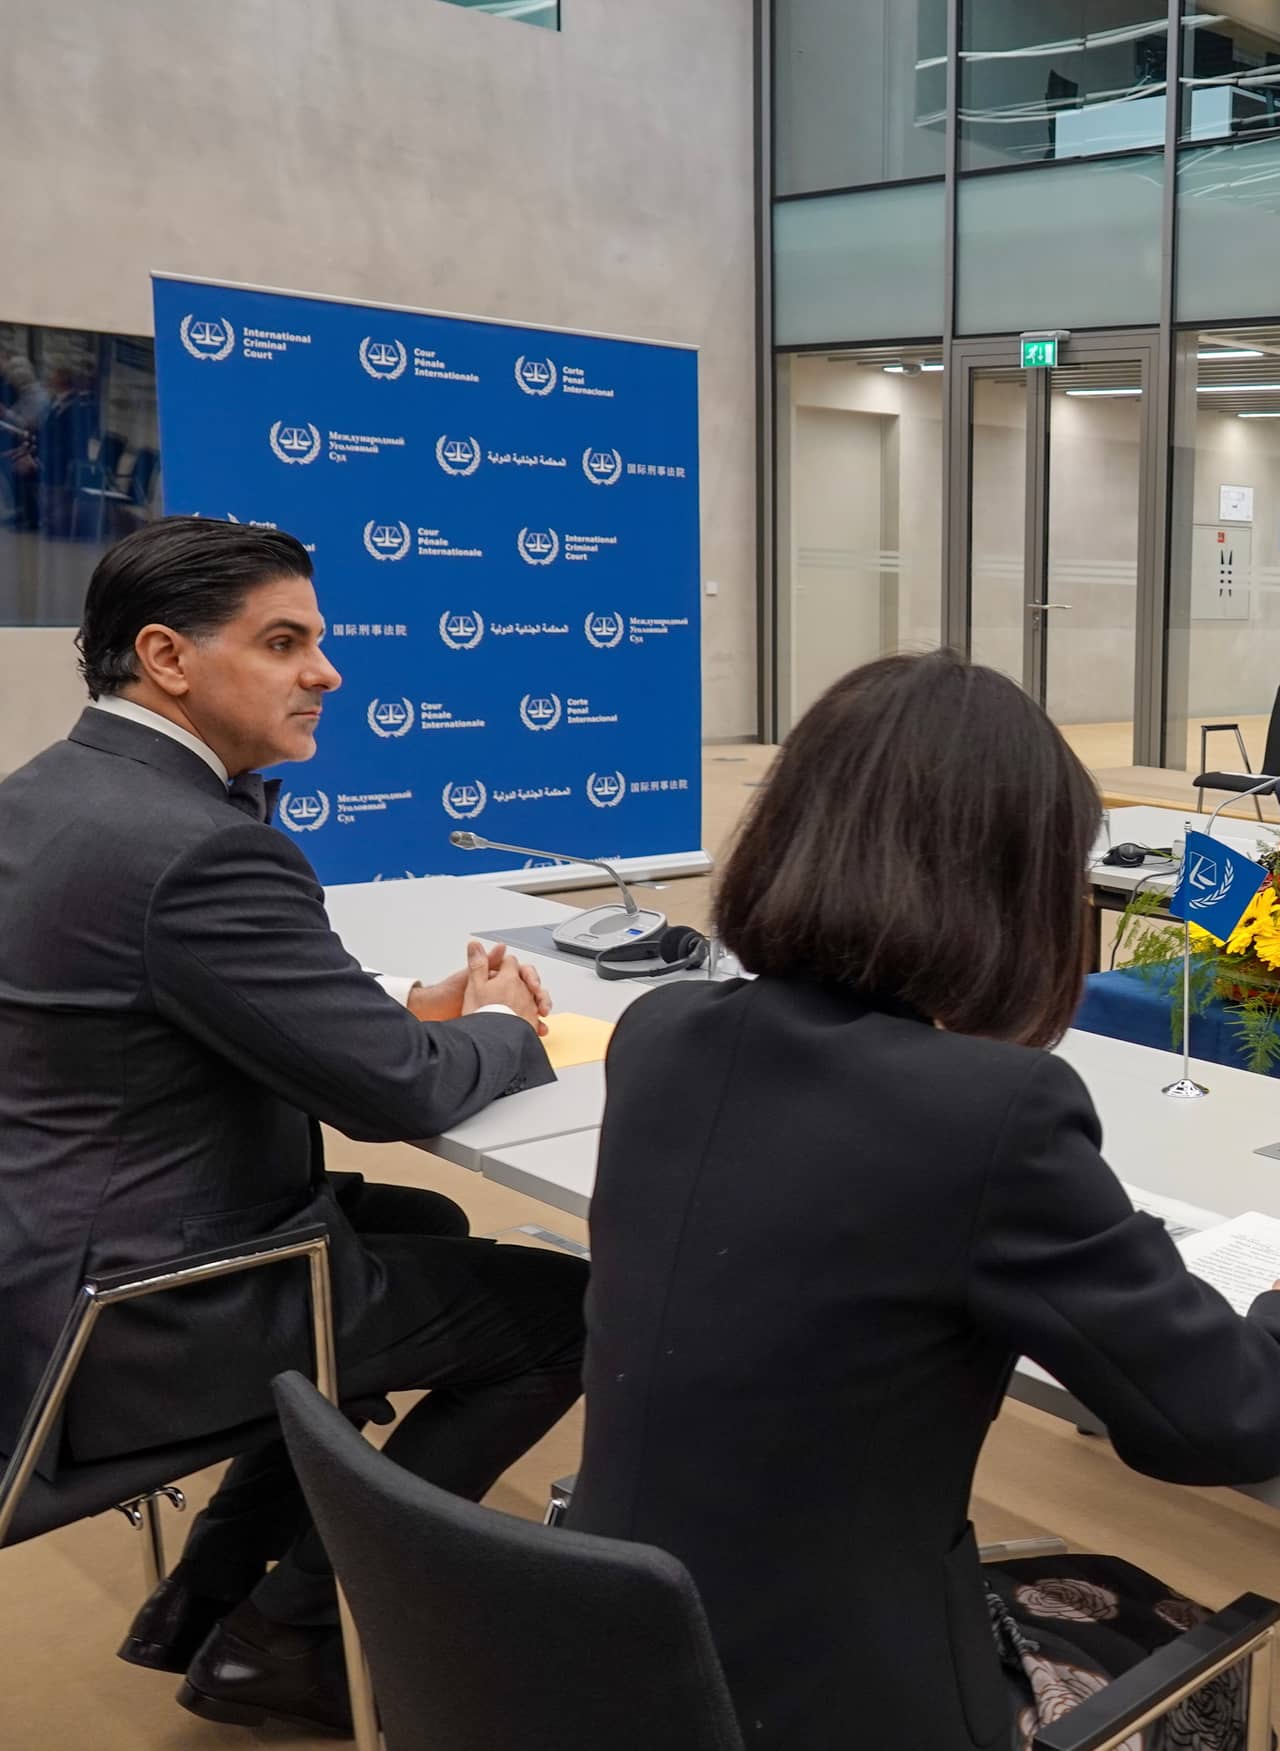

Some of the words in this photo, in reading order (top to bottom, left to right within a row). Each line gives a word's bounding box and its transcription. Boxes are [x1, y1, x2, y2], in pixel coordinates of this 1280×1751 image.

[243, 327, 311, 343] International
[243, 338, 287, 351] Criminal
[243, 348, 273, 360] Court
[414, 348, 436, 358] Cour
[414, 357, 445, 369] Pénale
[414, 367, 479, 382] Internationale
[562, 366, 584, 376] Corte
[562, 375, 585, 385] Penal
[563, 384, 614, 397] Internacional
[329, 451, 347, 463] Суд
[627, 463, 685, 478] 国际刑事法院
[417, 527, 440, 536] Cour
[418, 536, 449, 546] Pénale
[565, 534, 617, 544] International
[418, 546, 482, 557] Internationale
[565, 543, 598, 552] Criminal
[565, 552, 588, 561] Court
[333, 624, 407, 636] 国际刑事法院
[421, 702, 443, 711] Cour
[567, 698, 588, 706] Corte
[421, 711, 452, 720] Pénale
[567, 706, 589, 715] Penal
[421, 719, 485, 729] Internationale
[567, 714, 618, 724] Internacional
[630, 779, 688, 793] 国际刑事法院
